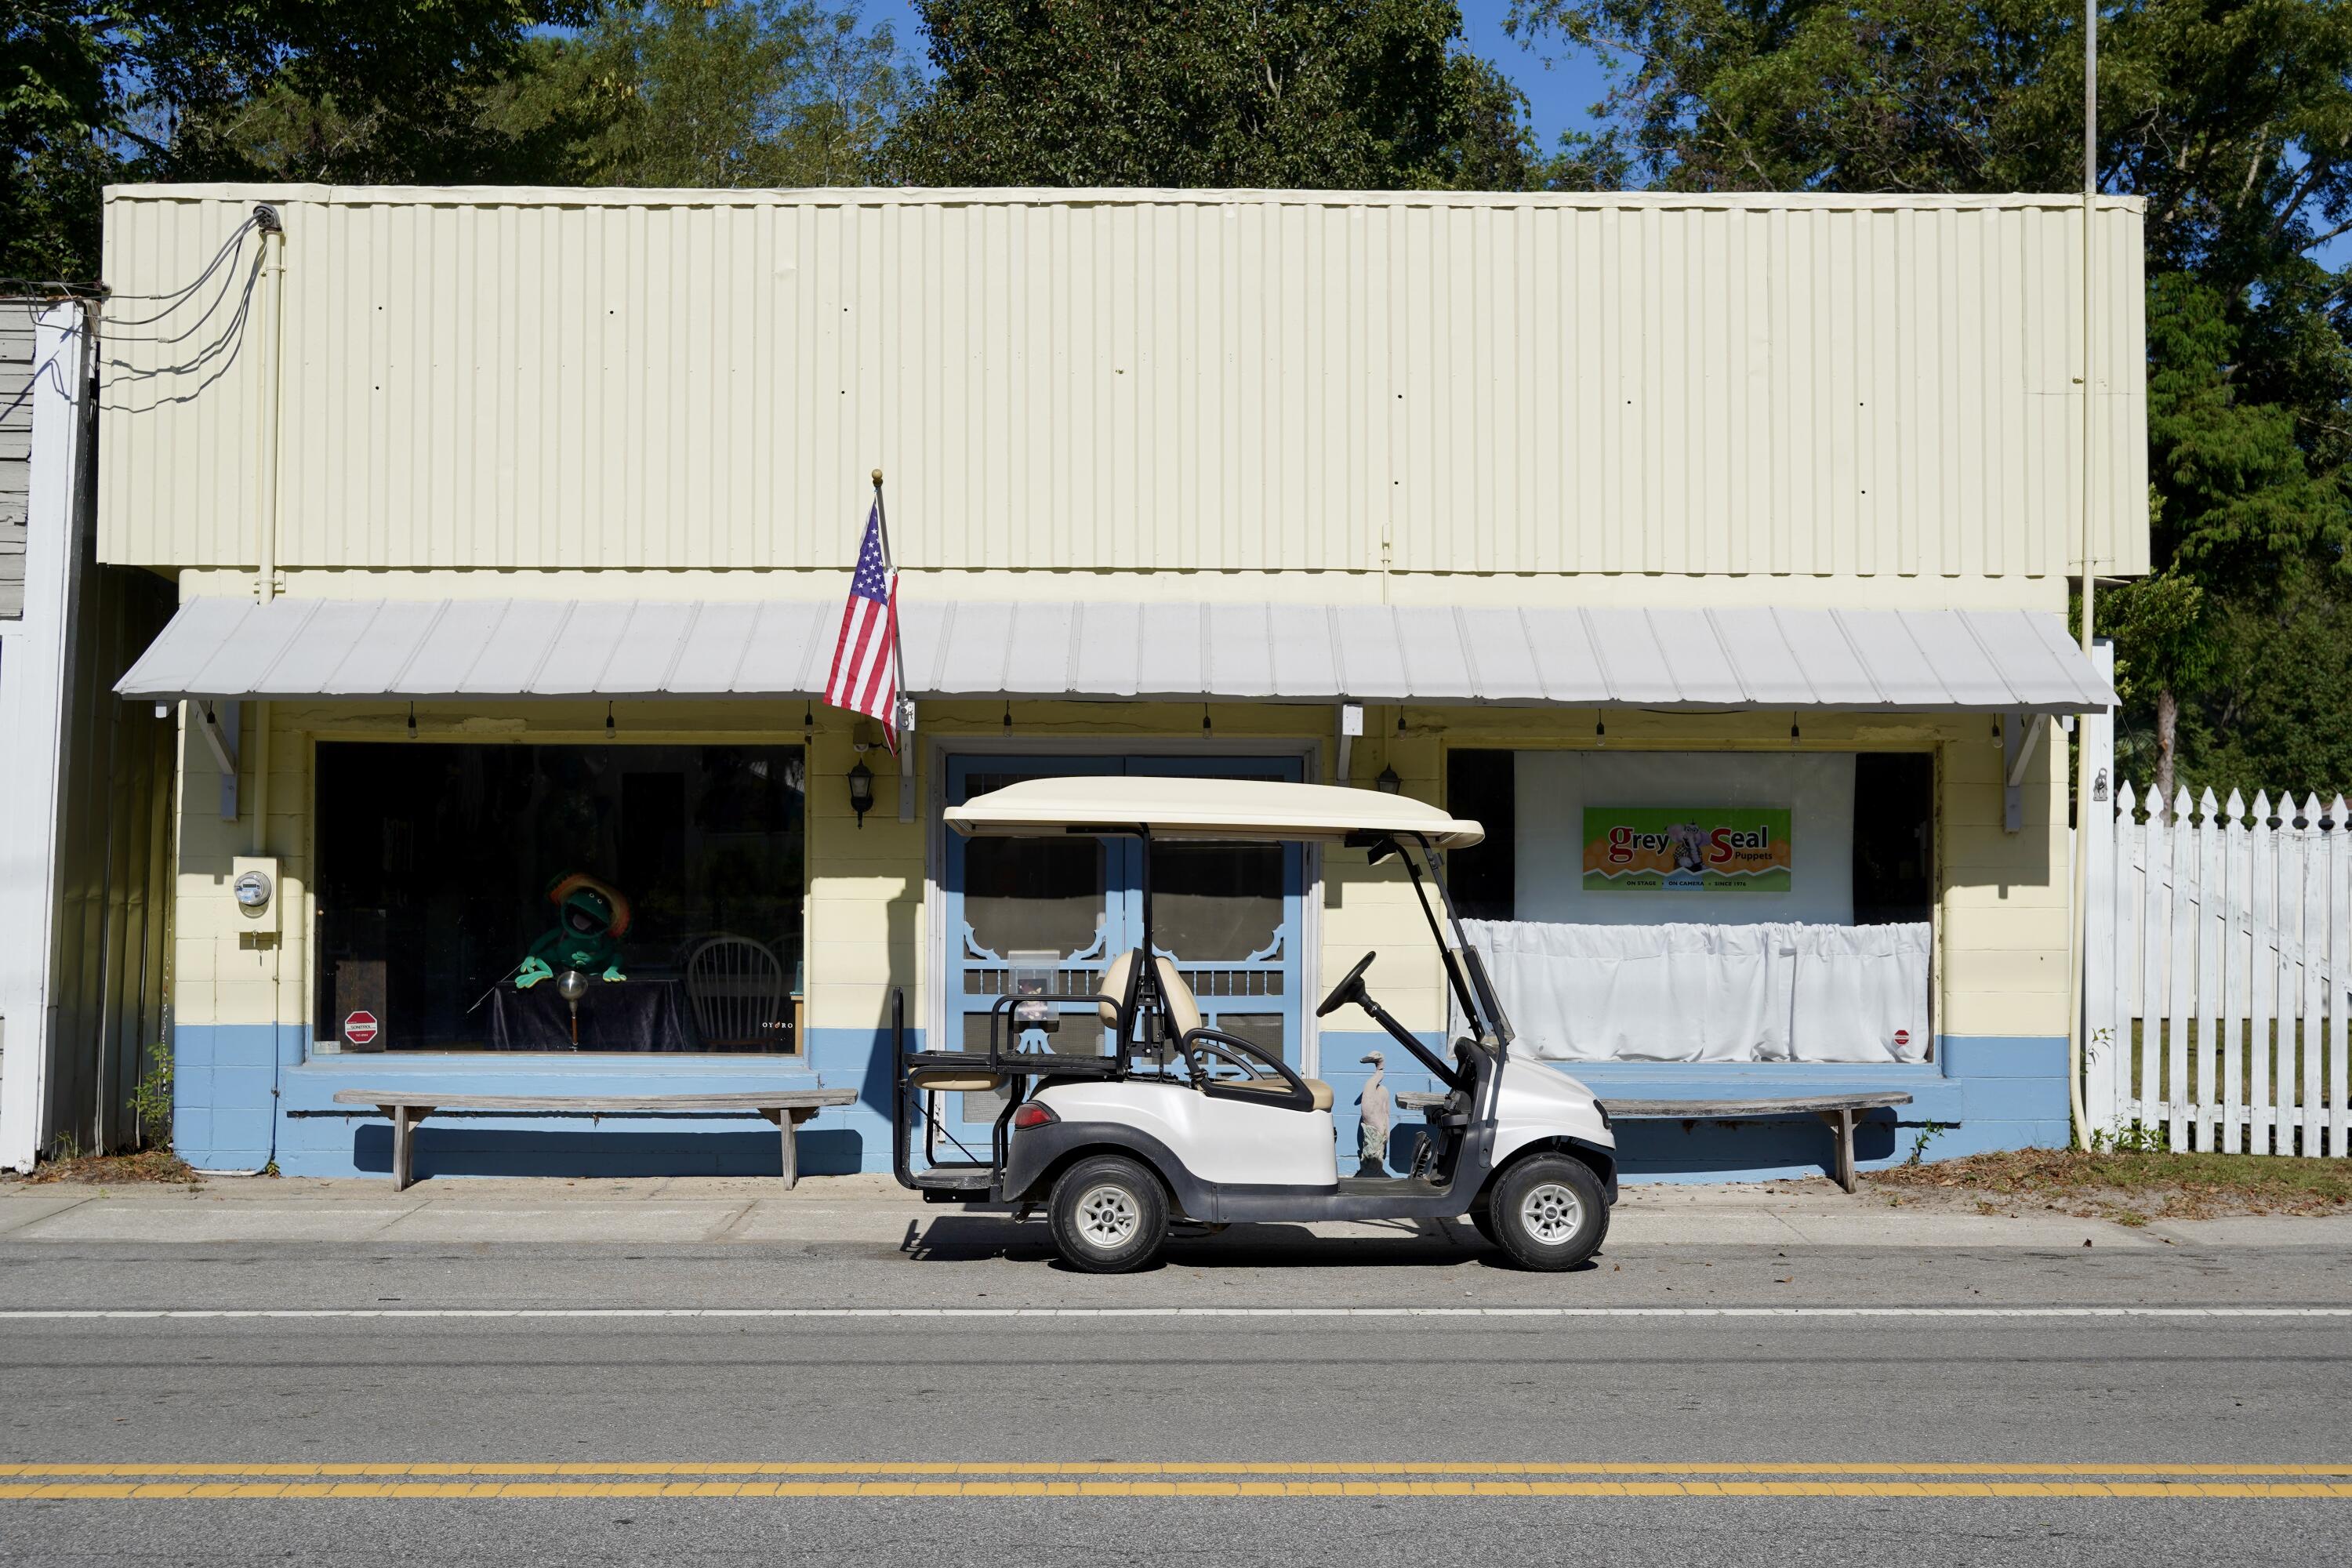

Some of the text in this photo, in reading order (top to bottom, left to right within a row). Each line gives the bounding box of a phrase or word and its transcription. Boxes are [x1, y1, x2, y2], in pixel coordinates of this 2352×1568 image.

[1609, 826, 1768, 863] grey Seal
[1735, 852, 1773, 861] Puppets
